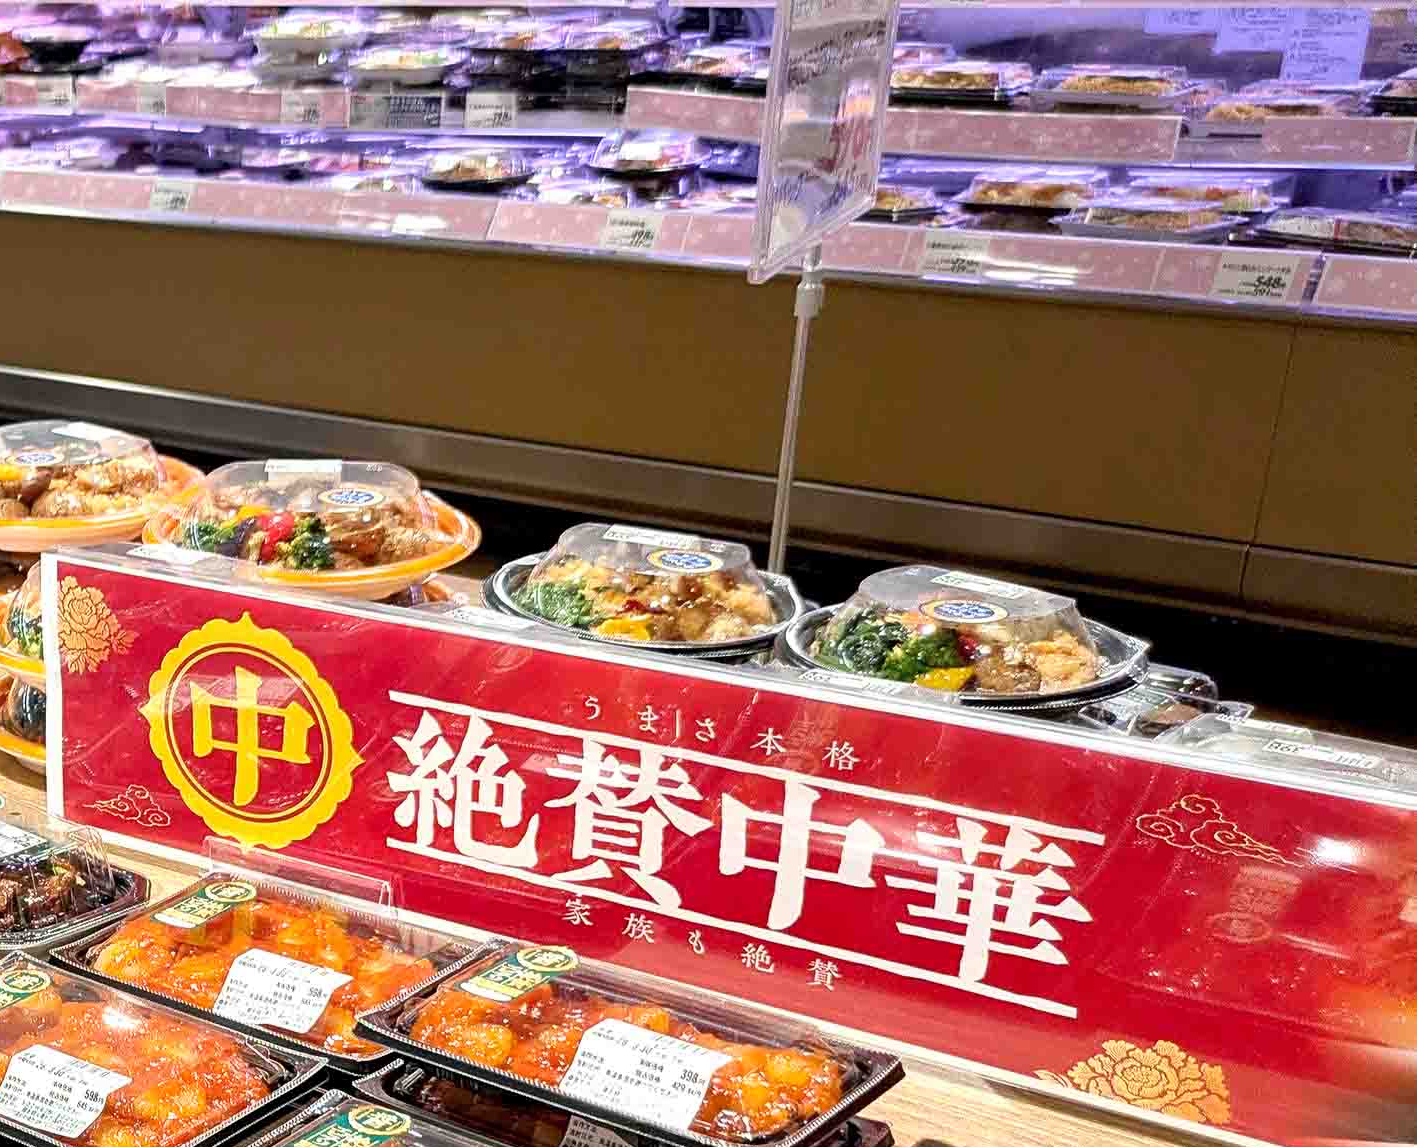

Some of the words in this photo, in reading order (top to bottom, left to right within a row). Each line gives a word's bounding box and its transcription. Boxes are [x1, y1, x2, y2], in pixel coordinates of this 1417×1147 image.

[189, 664, 316, 807] 中
[387, 708, 1094, 984] 絶賛中華
[562, 897, 844, 993] 家族も絶賛
